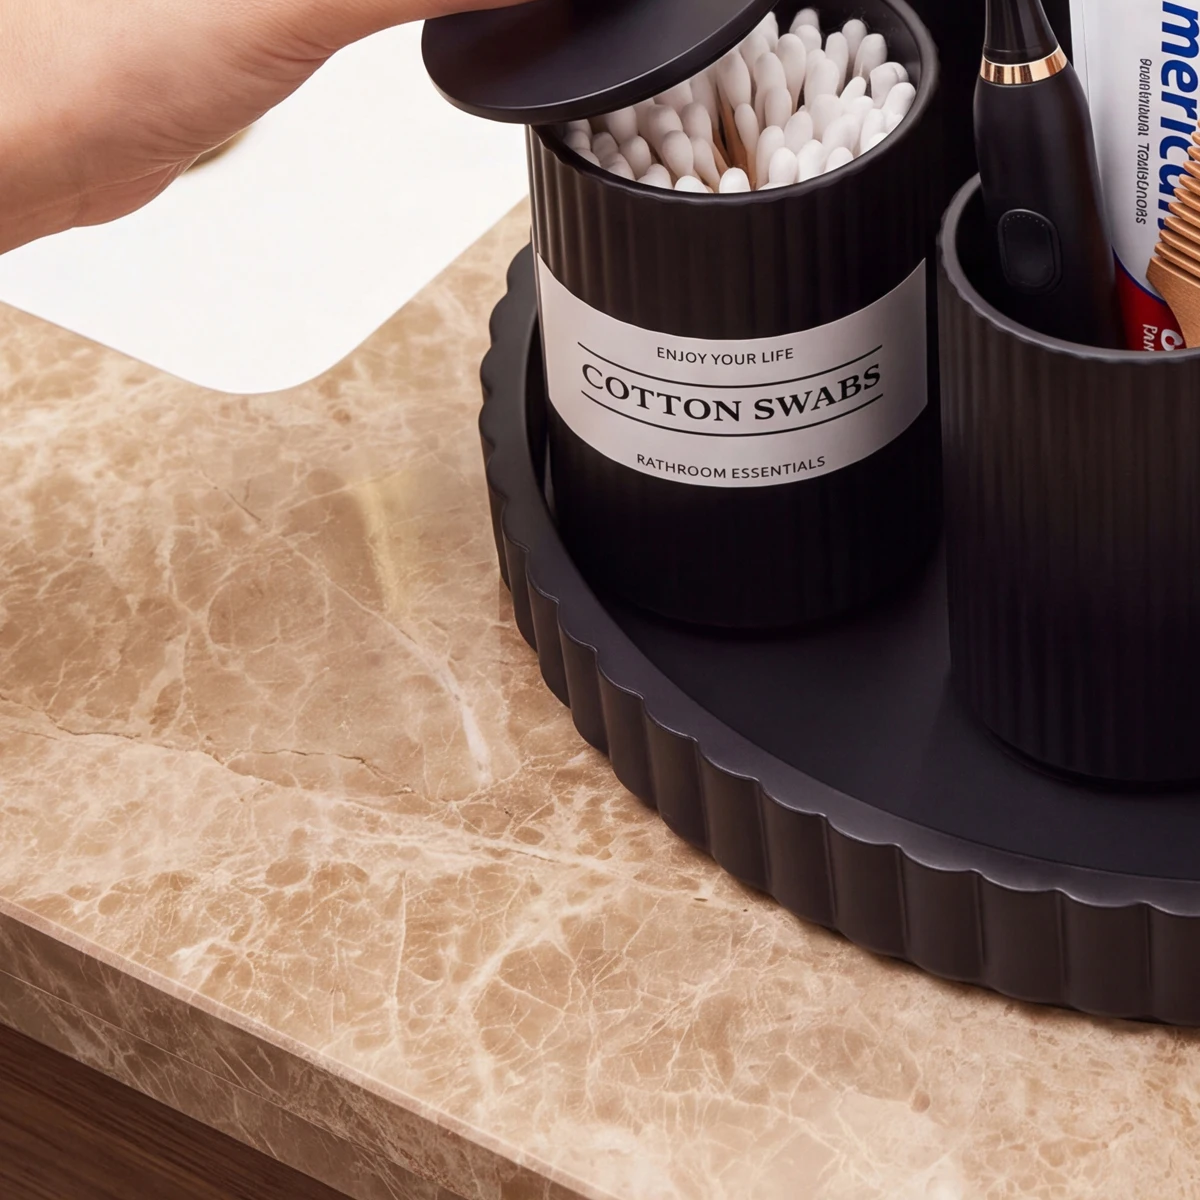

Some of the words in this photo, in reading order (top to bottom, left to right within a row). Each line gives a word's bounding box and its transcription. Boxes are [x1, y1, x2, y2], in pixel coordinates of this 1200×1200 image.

[657, 346, 708, 365] ENJOY
[710, 353, 757, 366] YOUR
[761, 347, 795, 364] LIFE
[582, 363, 742, 422] COTTON
[753, 363, 882, 421] SWABS
[636, 453, 727, 480] RATHROOM
[731, 455, 826, 480] ESSENTIALS
